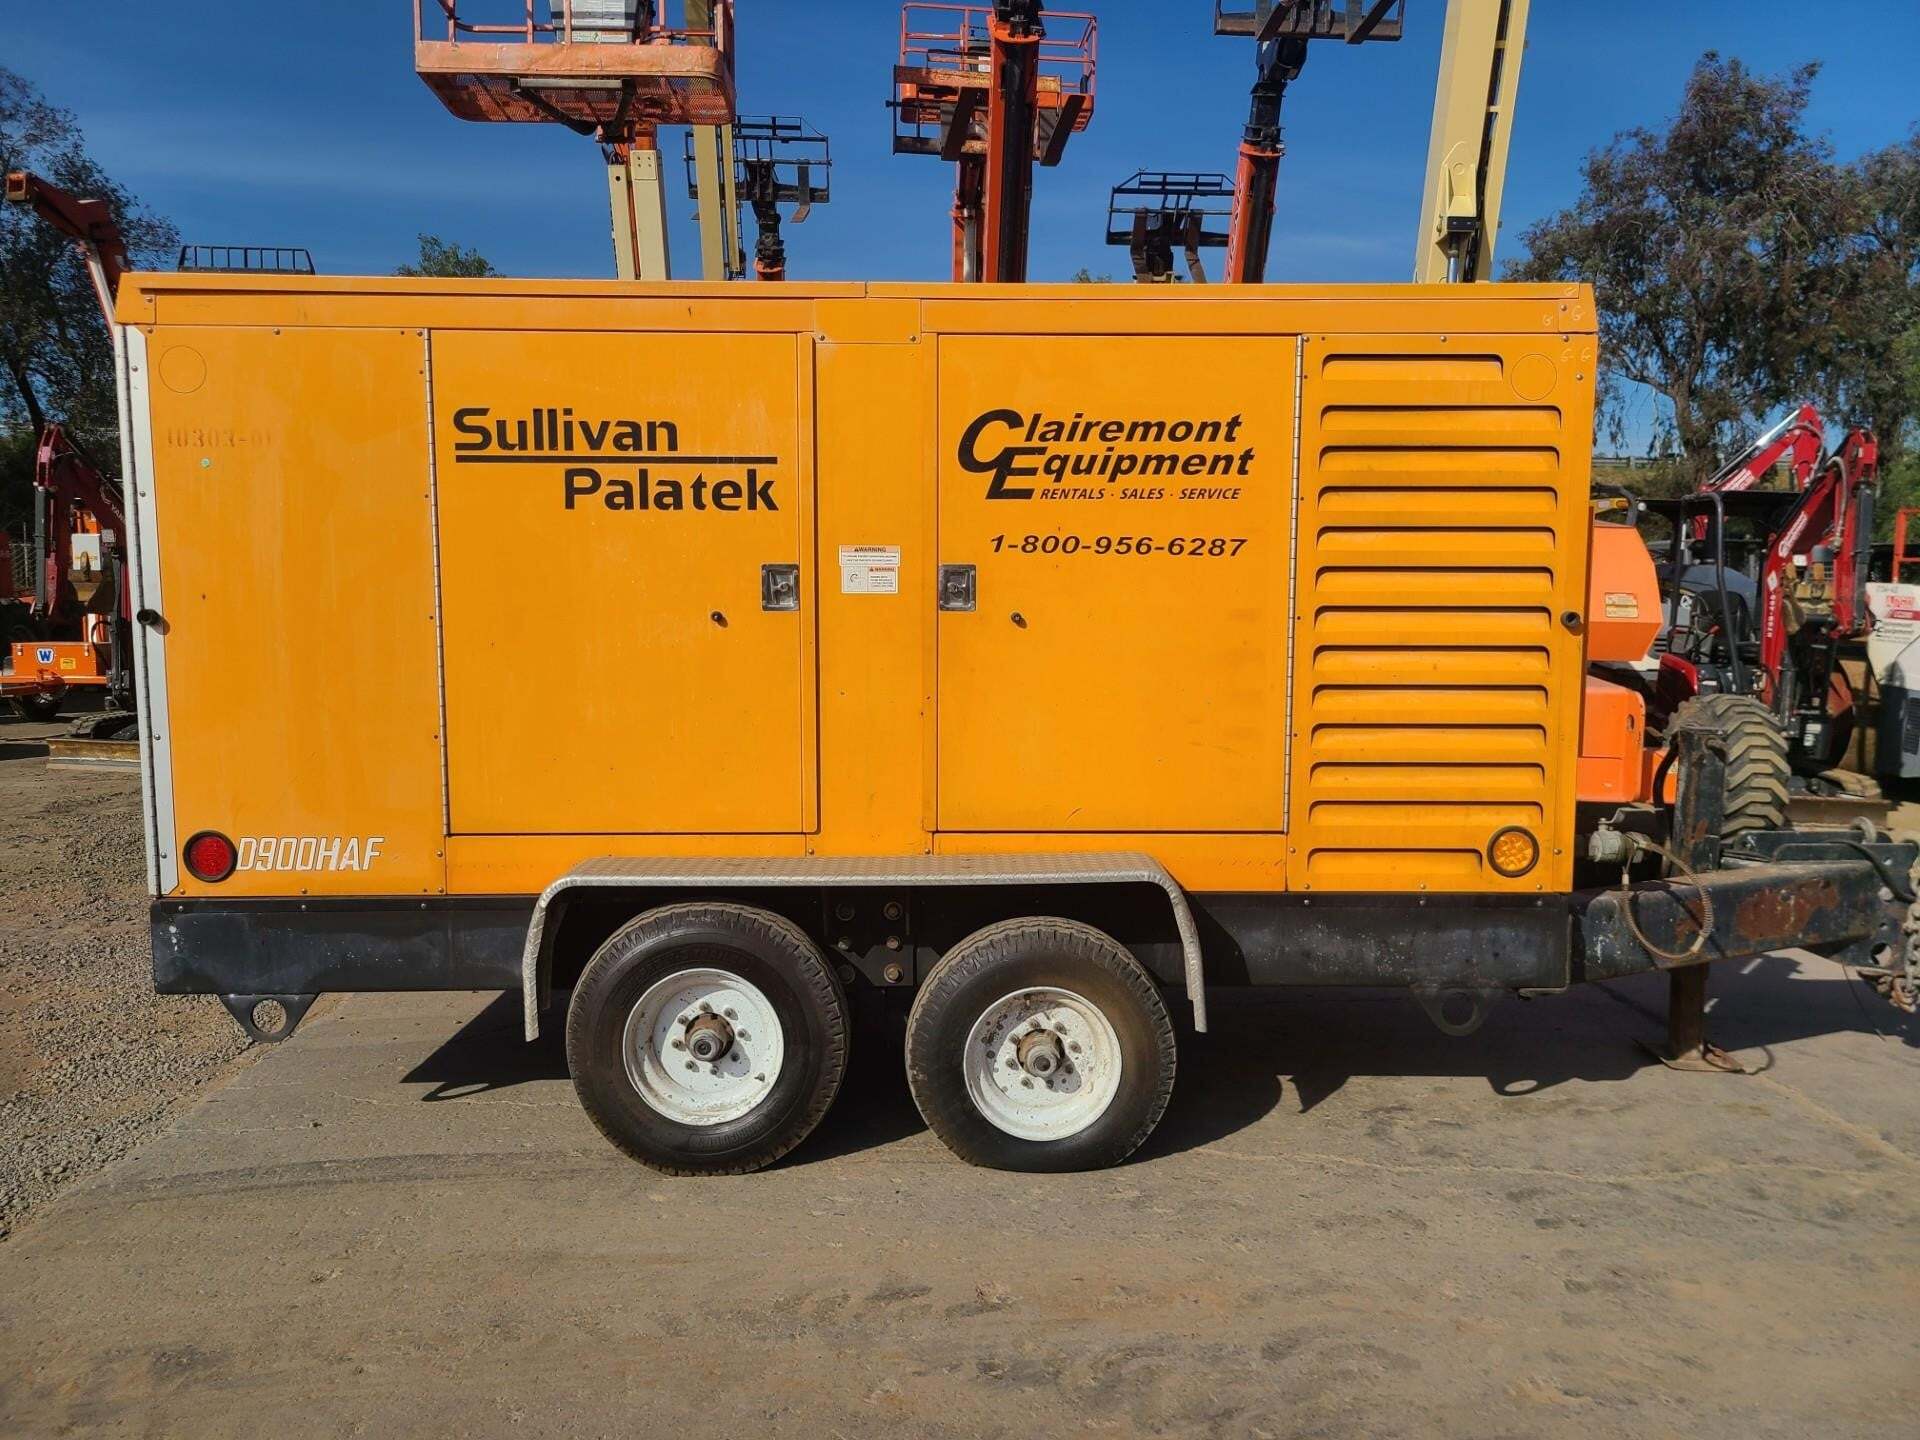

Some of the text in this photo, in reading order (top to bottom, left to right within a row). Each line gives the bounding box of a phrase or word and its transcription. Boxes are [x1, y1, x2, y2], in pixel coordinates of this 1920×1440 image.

[453, 407, 679, 452] Sullivan
[957, 408, 1242, 474] Clairemont
[563, 467, 780, 512] Palatek
[985, 446, 1255, 500] Equipment
[1040, 487, 1242, 500] RENTALS SALES SERVICE
[990, 534, 1248, 557] 1-800-956-6287
[39, 649, 52, 662] W
[235, 836, 385, 871] D900HAF
